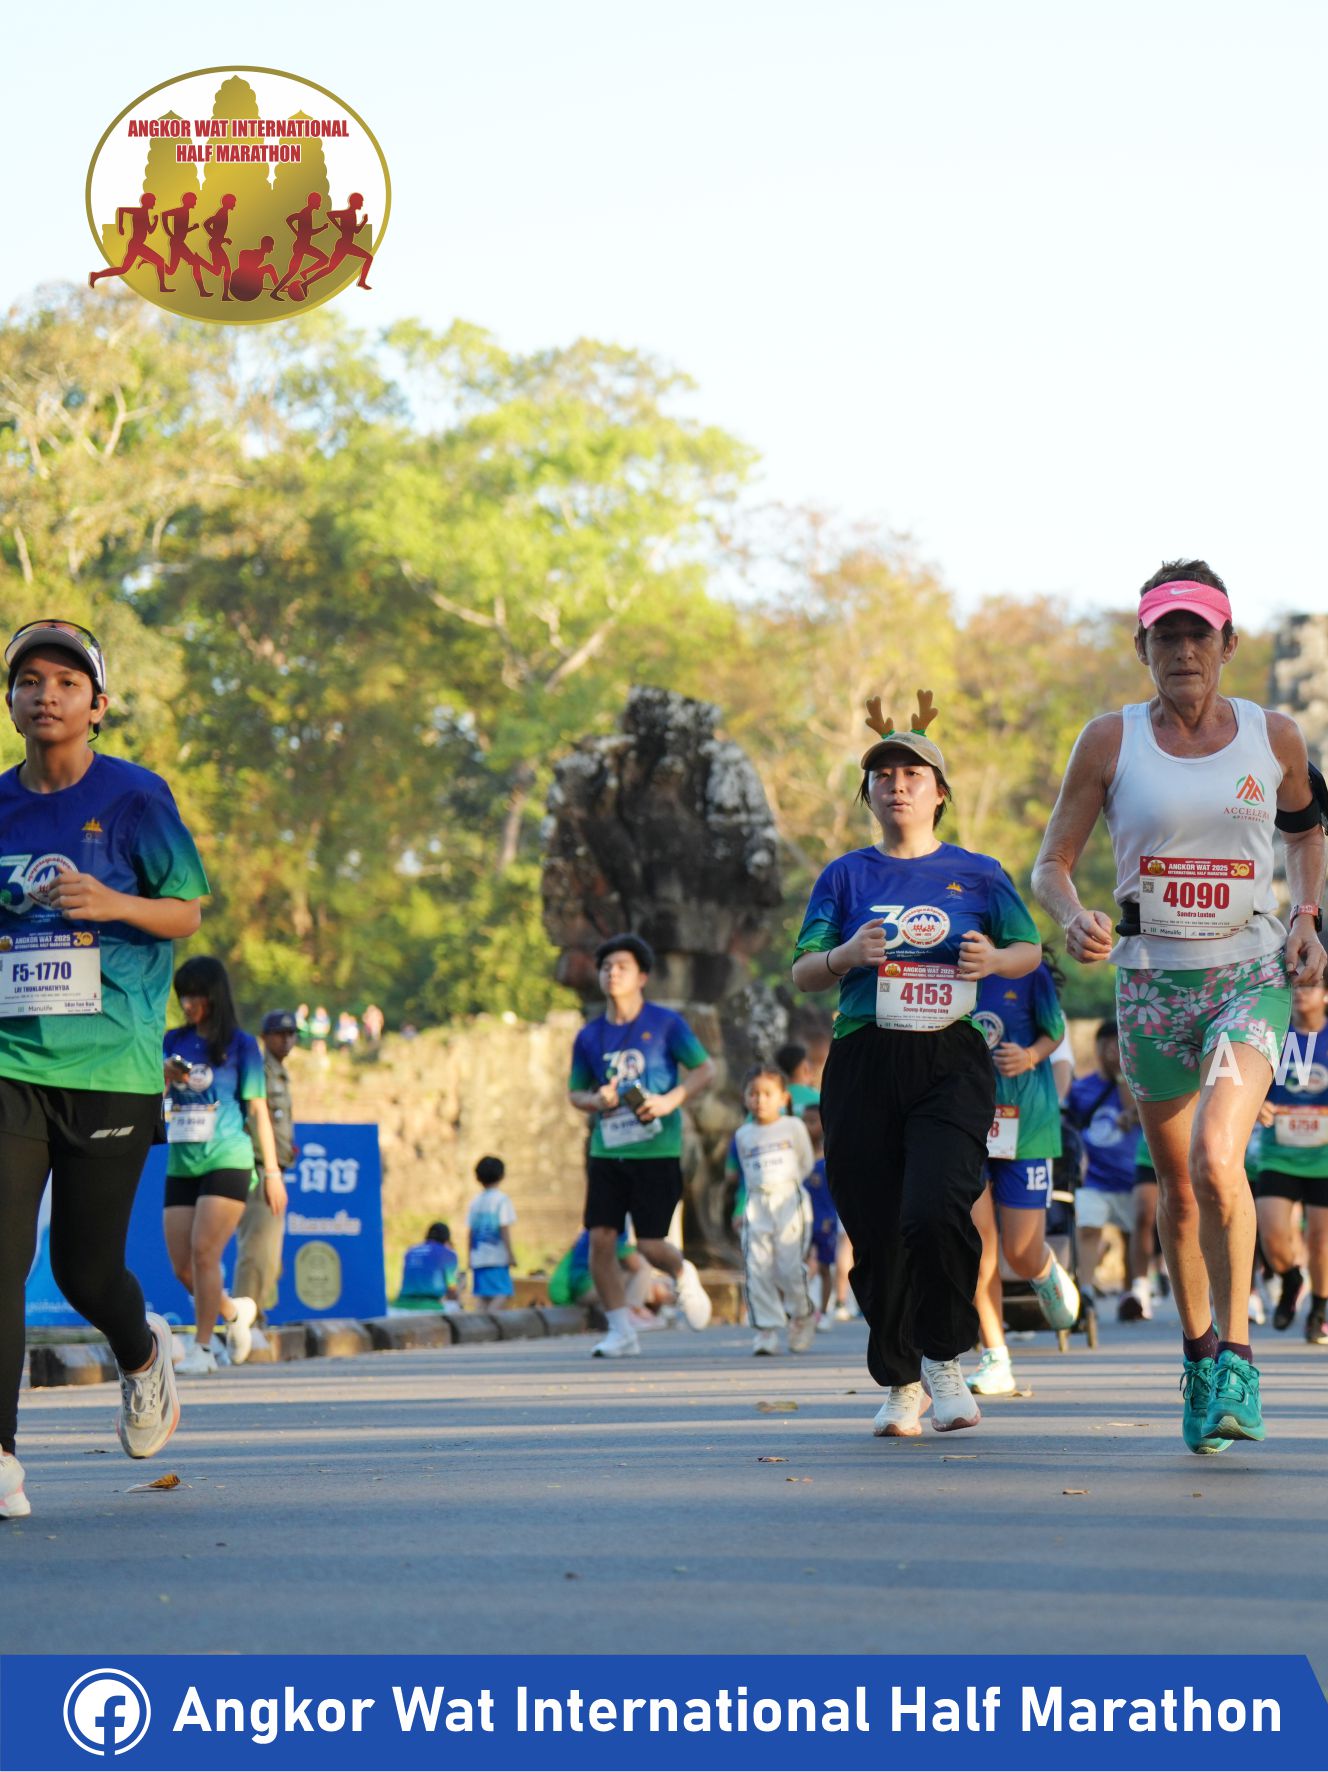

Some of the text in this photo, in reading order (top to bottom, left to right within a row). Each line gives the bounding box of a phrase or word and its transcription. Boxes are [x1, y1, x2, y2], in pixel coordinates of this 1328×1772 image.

[1168, 863, 1196, 871] ANGKOR
[1211, 864, 1229, 872] 2025
[1163, 881, 1230, 910] 4090
[1176, 910, 1197, 918] Sandra
[12, 961, 72, 982] F5-1770
[900, 982, 953, 1006] 4153
[28, 1004, 53, 1012] Manulife
[1026, 1165, 1048, 1191] 12
